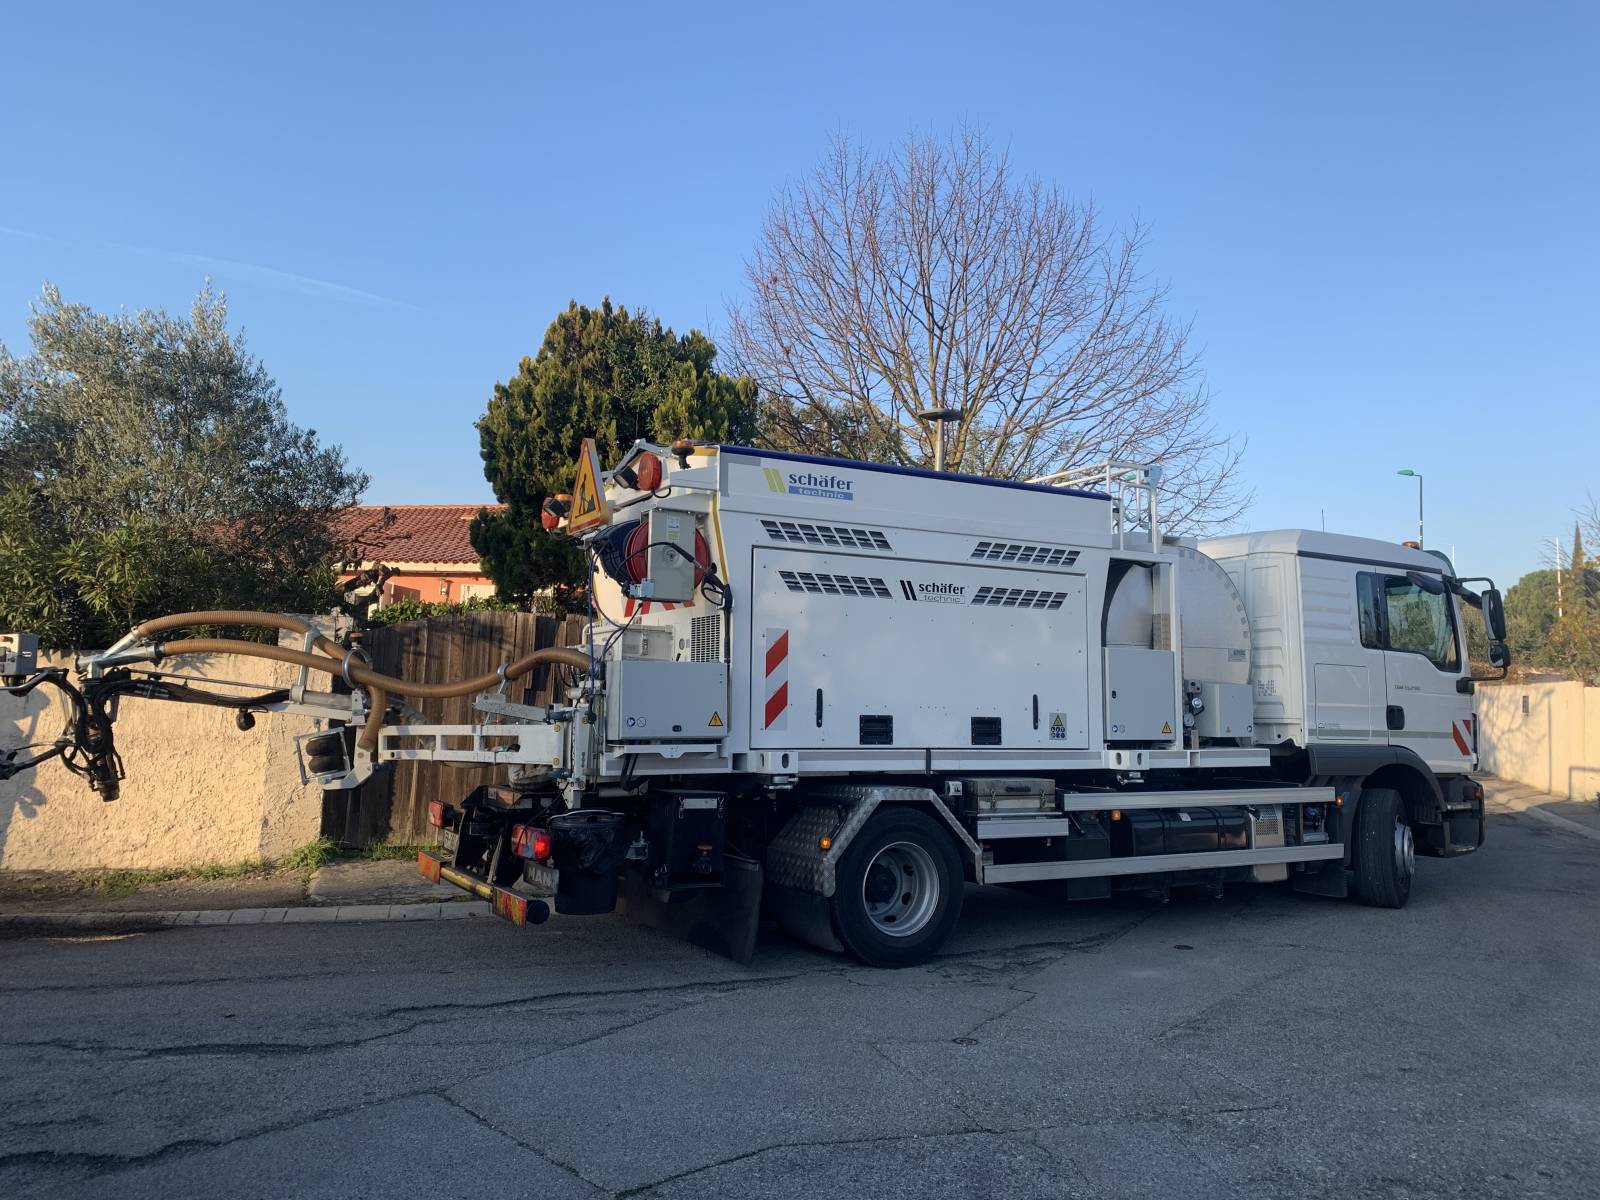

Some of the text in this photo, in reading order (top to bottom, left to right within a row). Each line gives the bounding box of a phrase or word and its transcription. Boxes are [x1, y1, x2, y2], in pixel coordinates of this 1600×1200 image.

[789, 473, 854, 491] schäfer
[799, 488, 845, 499] technic
[918, 582, 965, 595] schäfer
[528, 866, 552, 887] MAN
